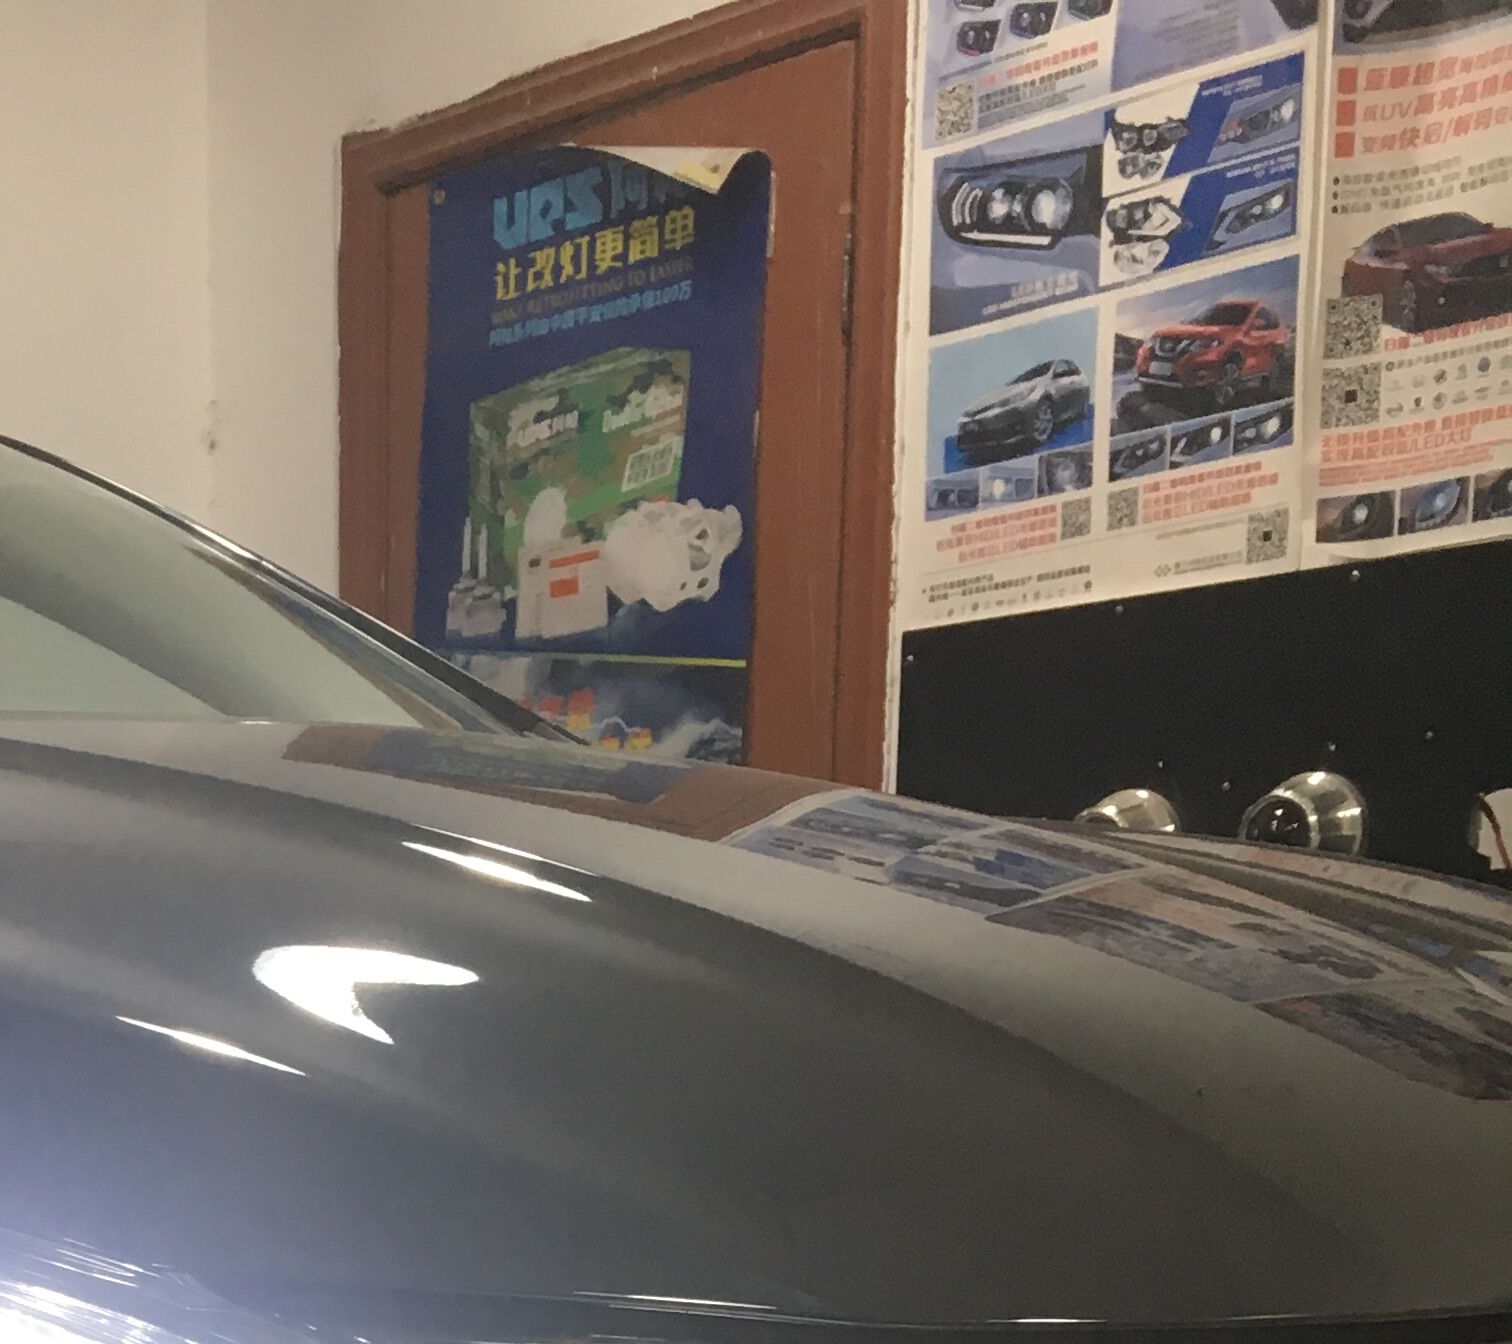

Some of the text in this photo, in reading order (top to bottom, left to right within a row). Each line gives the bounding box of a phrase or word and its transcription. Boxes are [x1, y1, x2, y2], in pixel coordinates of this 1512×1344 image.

[494, 205, 696, 301] 让改灯更简单
